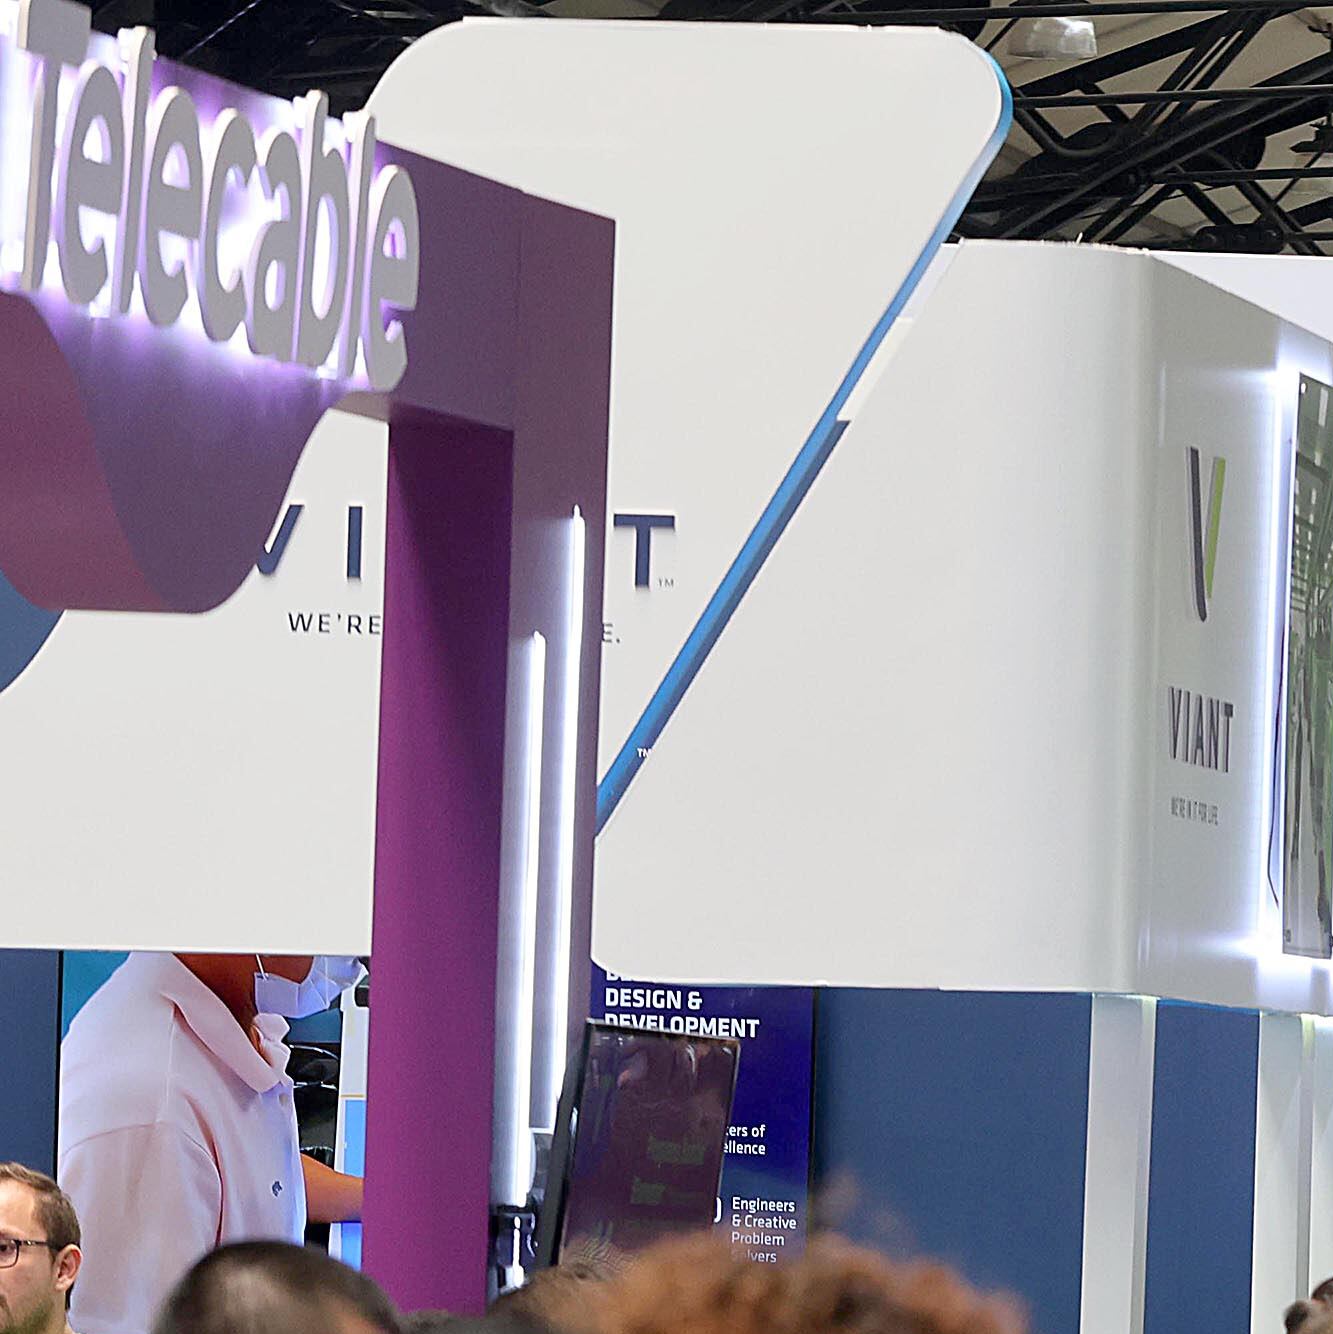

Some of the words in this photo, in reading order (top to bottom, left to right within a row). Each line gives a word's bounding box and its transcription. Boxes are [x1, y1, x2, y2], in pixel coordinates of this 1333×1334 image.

[18, 0, 419, 391] Telecable
[258, 504, 675, 588] VIT
[288, 612, 380, 636] WE'RE
[1169, 686, 1234, 773] VIANT
[605, 987, 682, 1010] DESIGN
[687, 991, 703, 1010] &
[751, 1124, 766, 1138] of
[732, 1196, 796, 1213] Engineers
[732, 1214, 742, 1227] &
[744, 1214, 797, 1230] Creative
[731, 1231, 785, 1246] Problem
